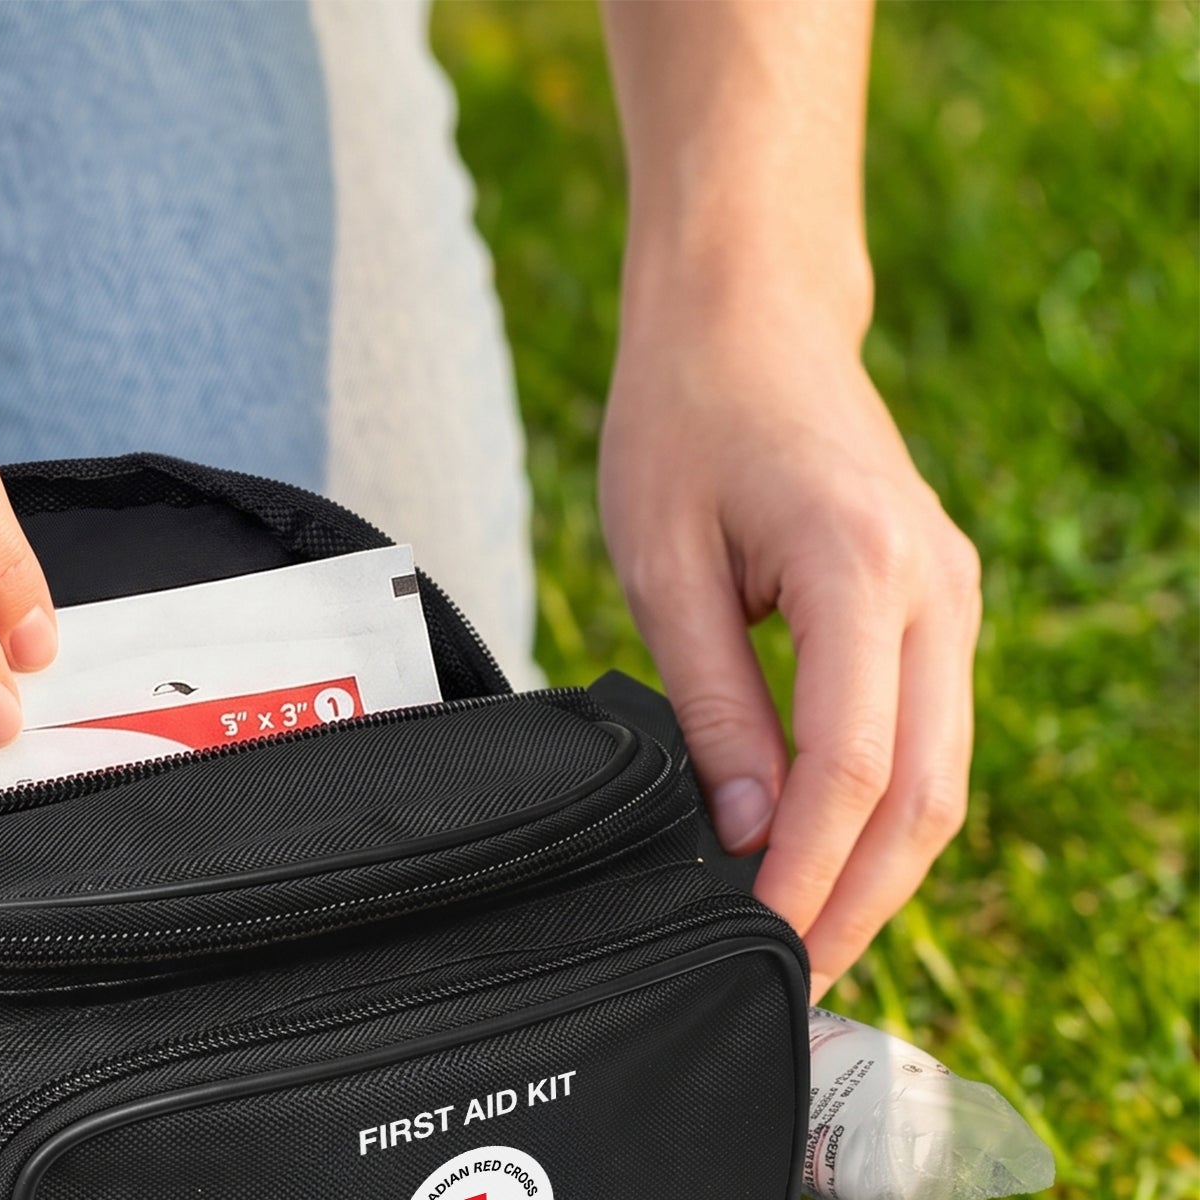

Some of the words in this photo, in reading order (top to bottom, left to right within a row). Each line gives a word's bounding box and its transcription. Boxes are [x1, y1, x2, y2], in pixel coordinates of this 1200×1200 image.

[358, 1105, 455, 1156] FIRST
[463, 1088, 518, 1126] AID
[527, 1070, 577, 1107] KIT
[473, 1159, 502, 1174] RED
[503, 1162, 538, 1197] CROSS
